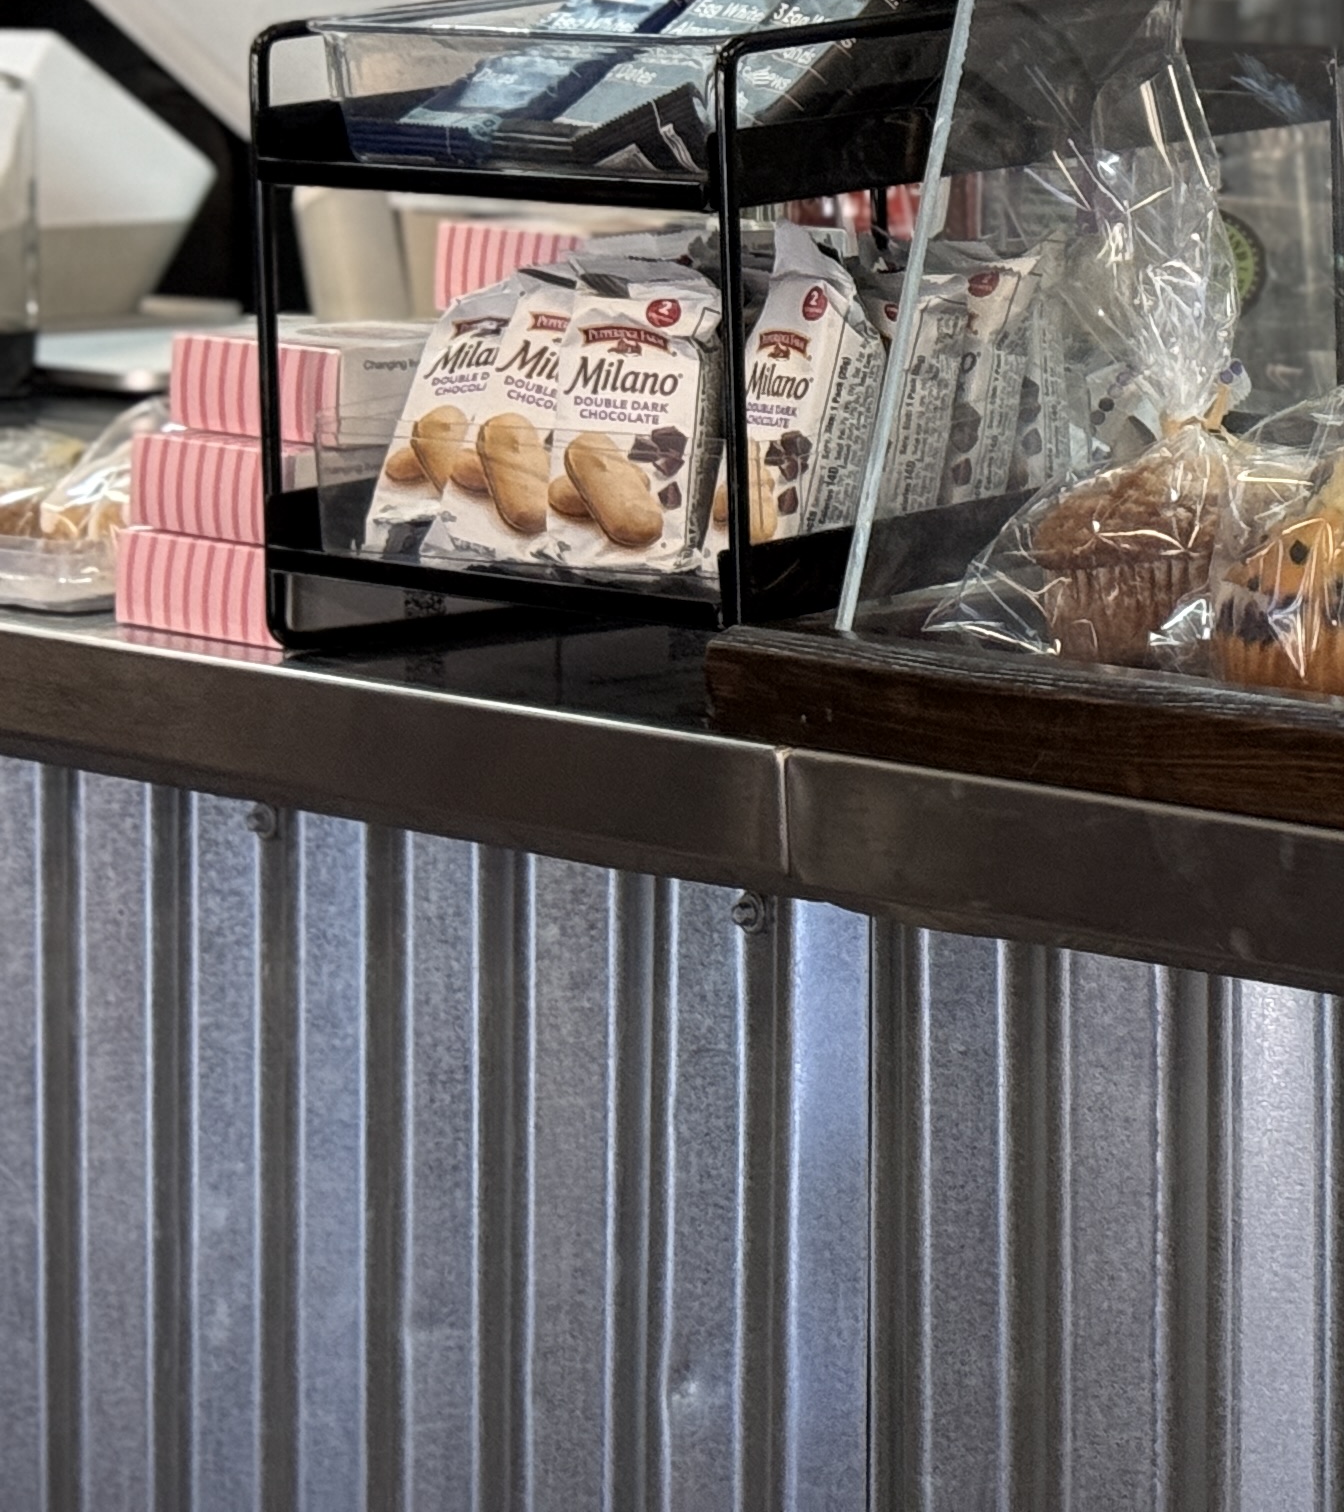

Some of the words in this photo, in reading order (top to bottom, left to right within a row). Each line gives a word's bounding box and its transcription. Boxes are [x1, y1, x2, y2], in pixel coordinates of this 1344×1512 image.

[722, 3, 765, 23] White
[809, 290, 818, 306] 2
[658, 300, 673, 316] 2
[363, 359, 407, 371] Changing
[495, 339, 559, 381] Mil
[431, 373, 479, 386] DOUBLE
[563, 356, 679, 397] Milano
[747, 360, 810, 401] Milano
[435, 383, 488, 396] CHOCOL
[504, 375, 558, 399] DOUBLE
[573, 395, 628, 410] DOUBLE
[631, 400, 669, 414] DARK
[579, 409, 661, 426] CHOCOLATE
